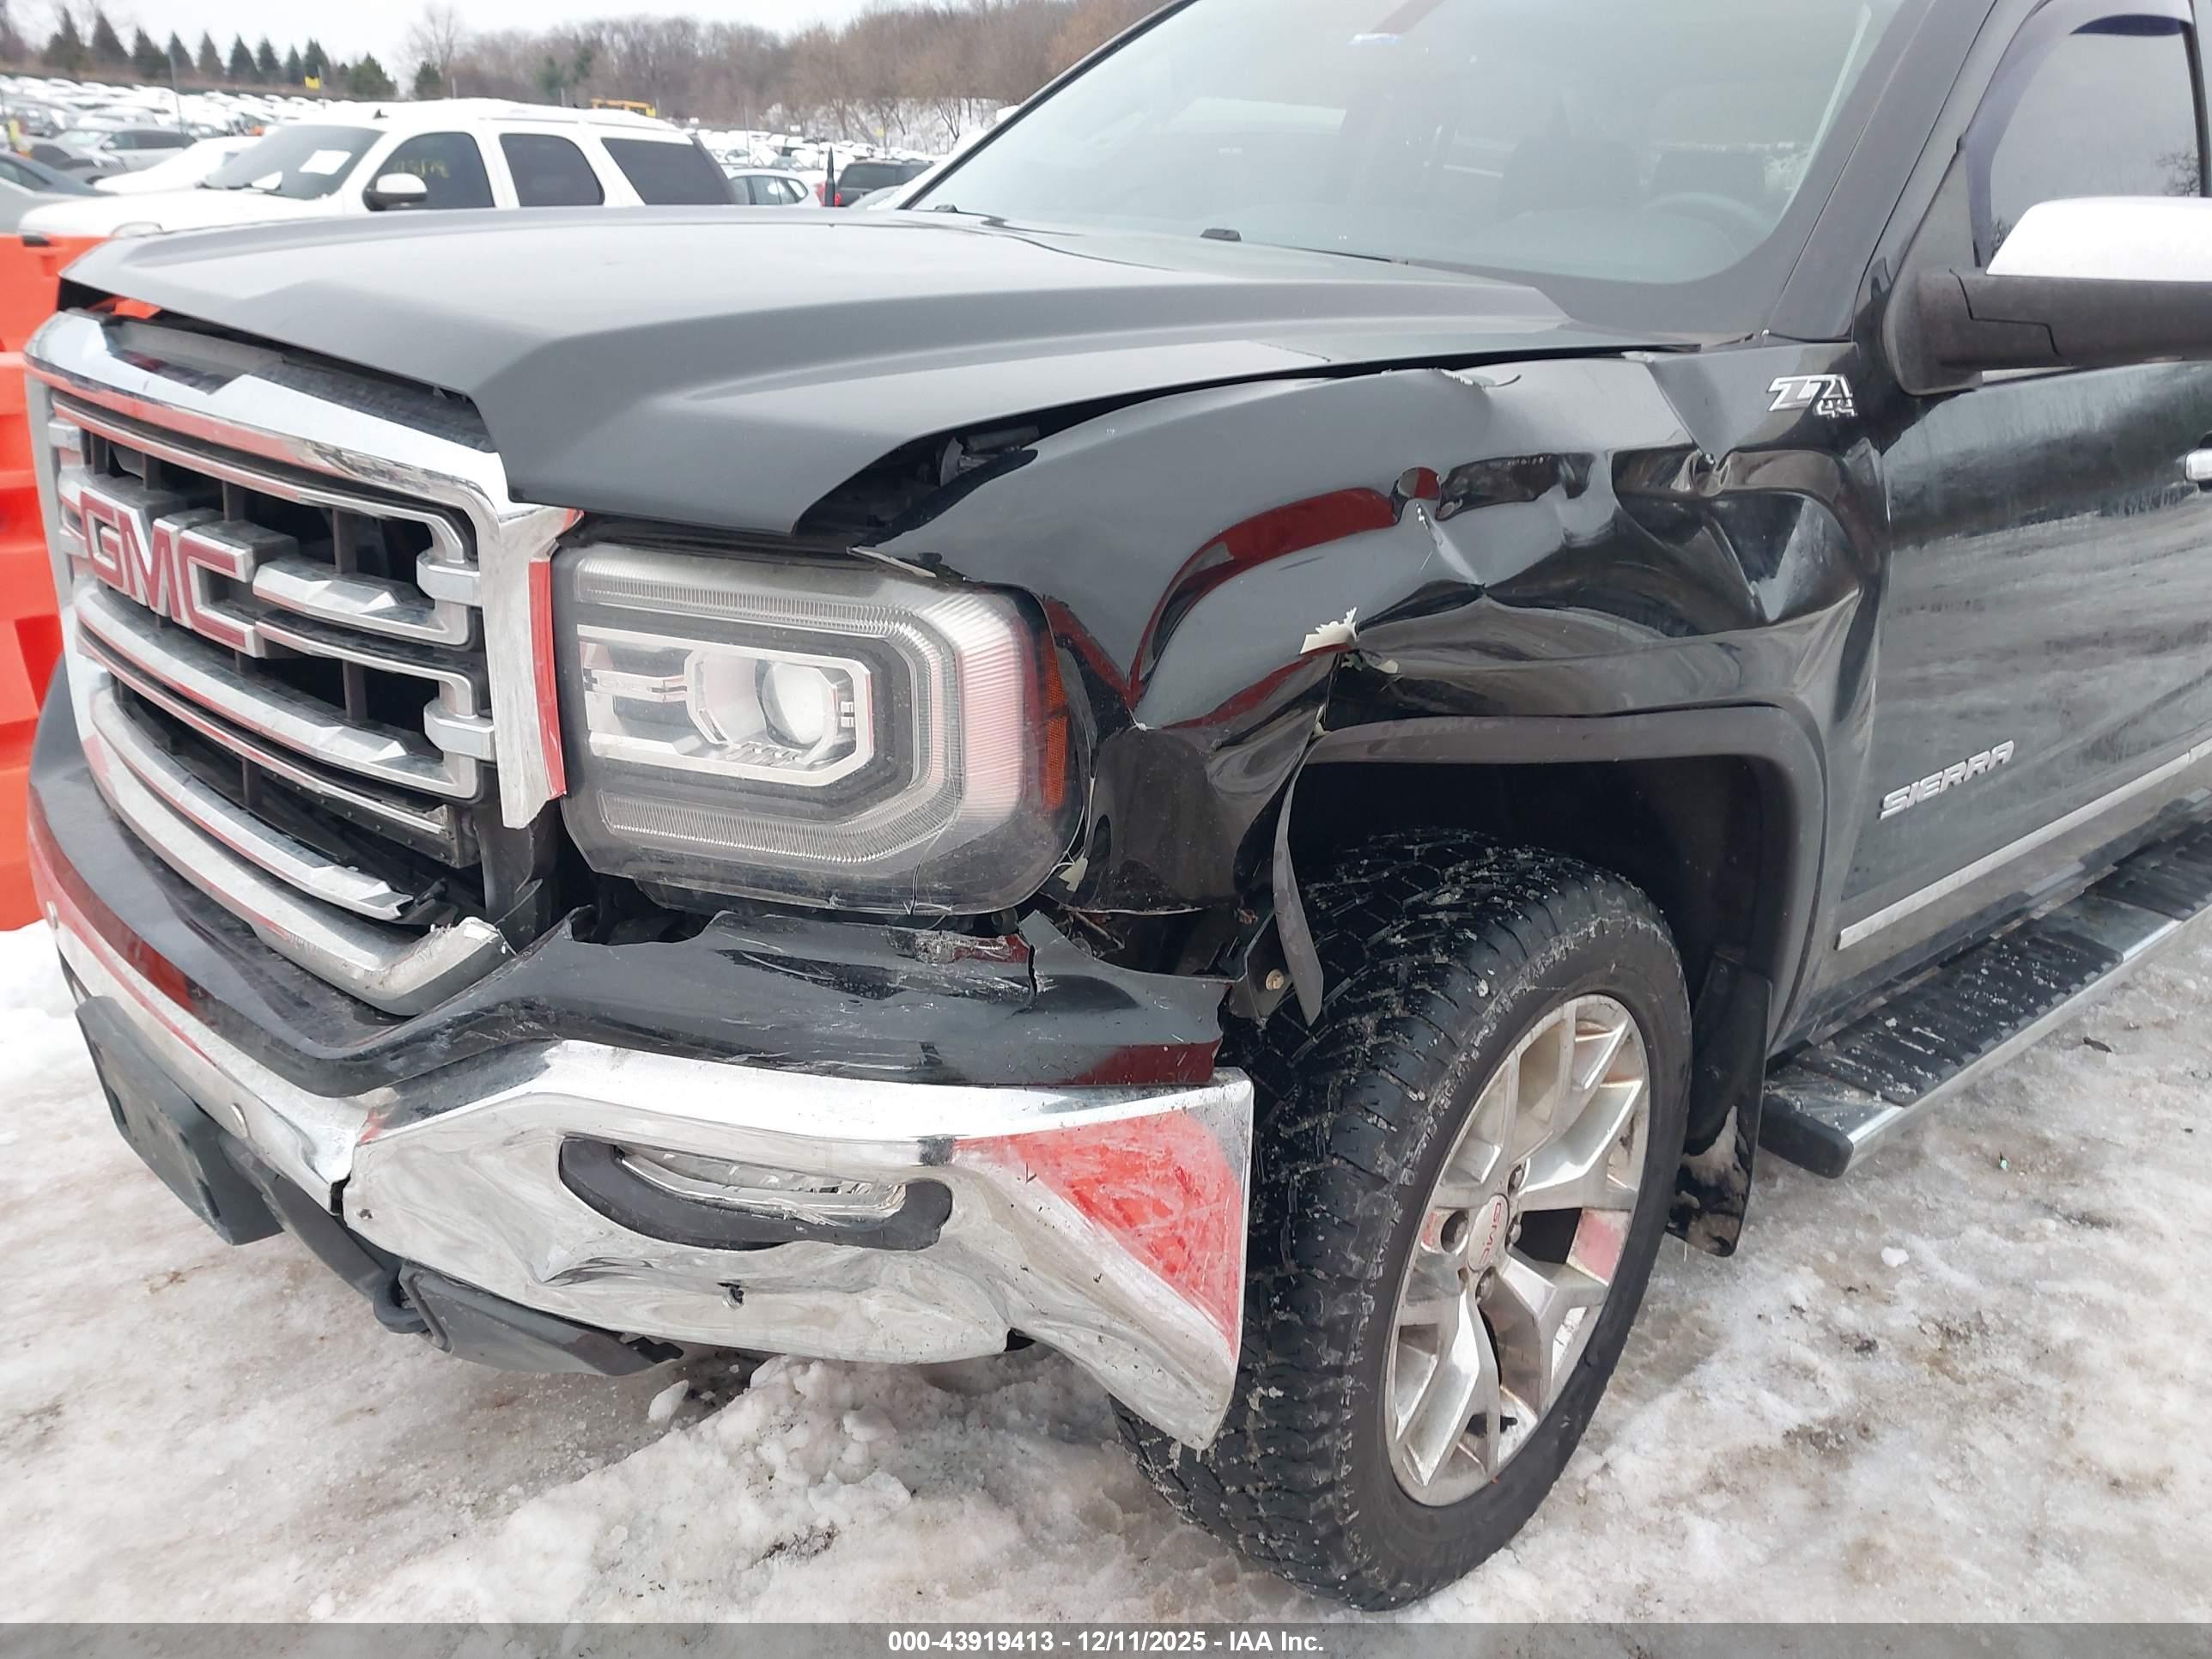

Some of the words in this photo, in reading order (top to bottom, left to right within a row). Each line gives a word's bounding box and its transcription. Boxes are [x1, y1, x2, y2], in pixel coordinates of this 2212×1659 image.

[1766, 374, 1853, 412] Z71
[80, 486, 262, 658] GMC
[1879, 739, 2014, 821] SIERRA
[1479, 1202, 1502, 1266] GMC
